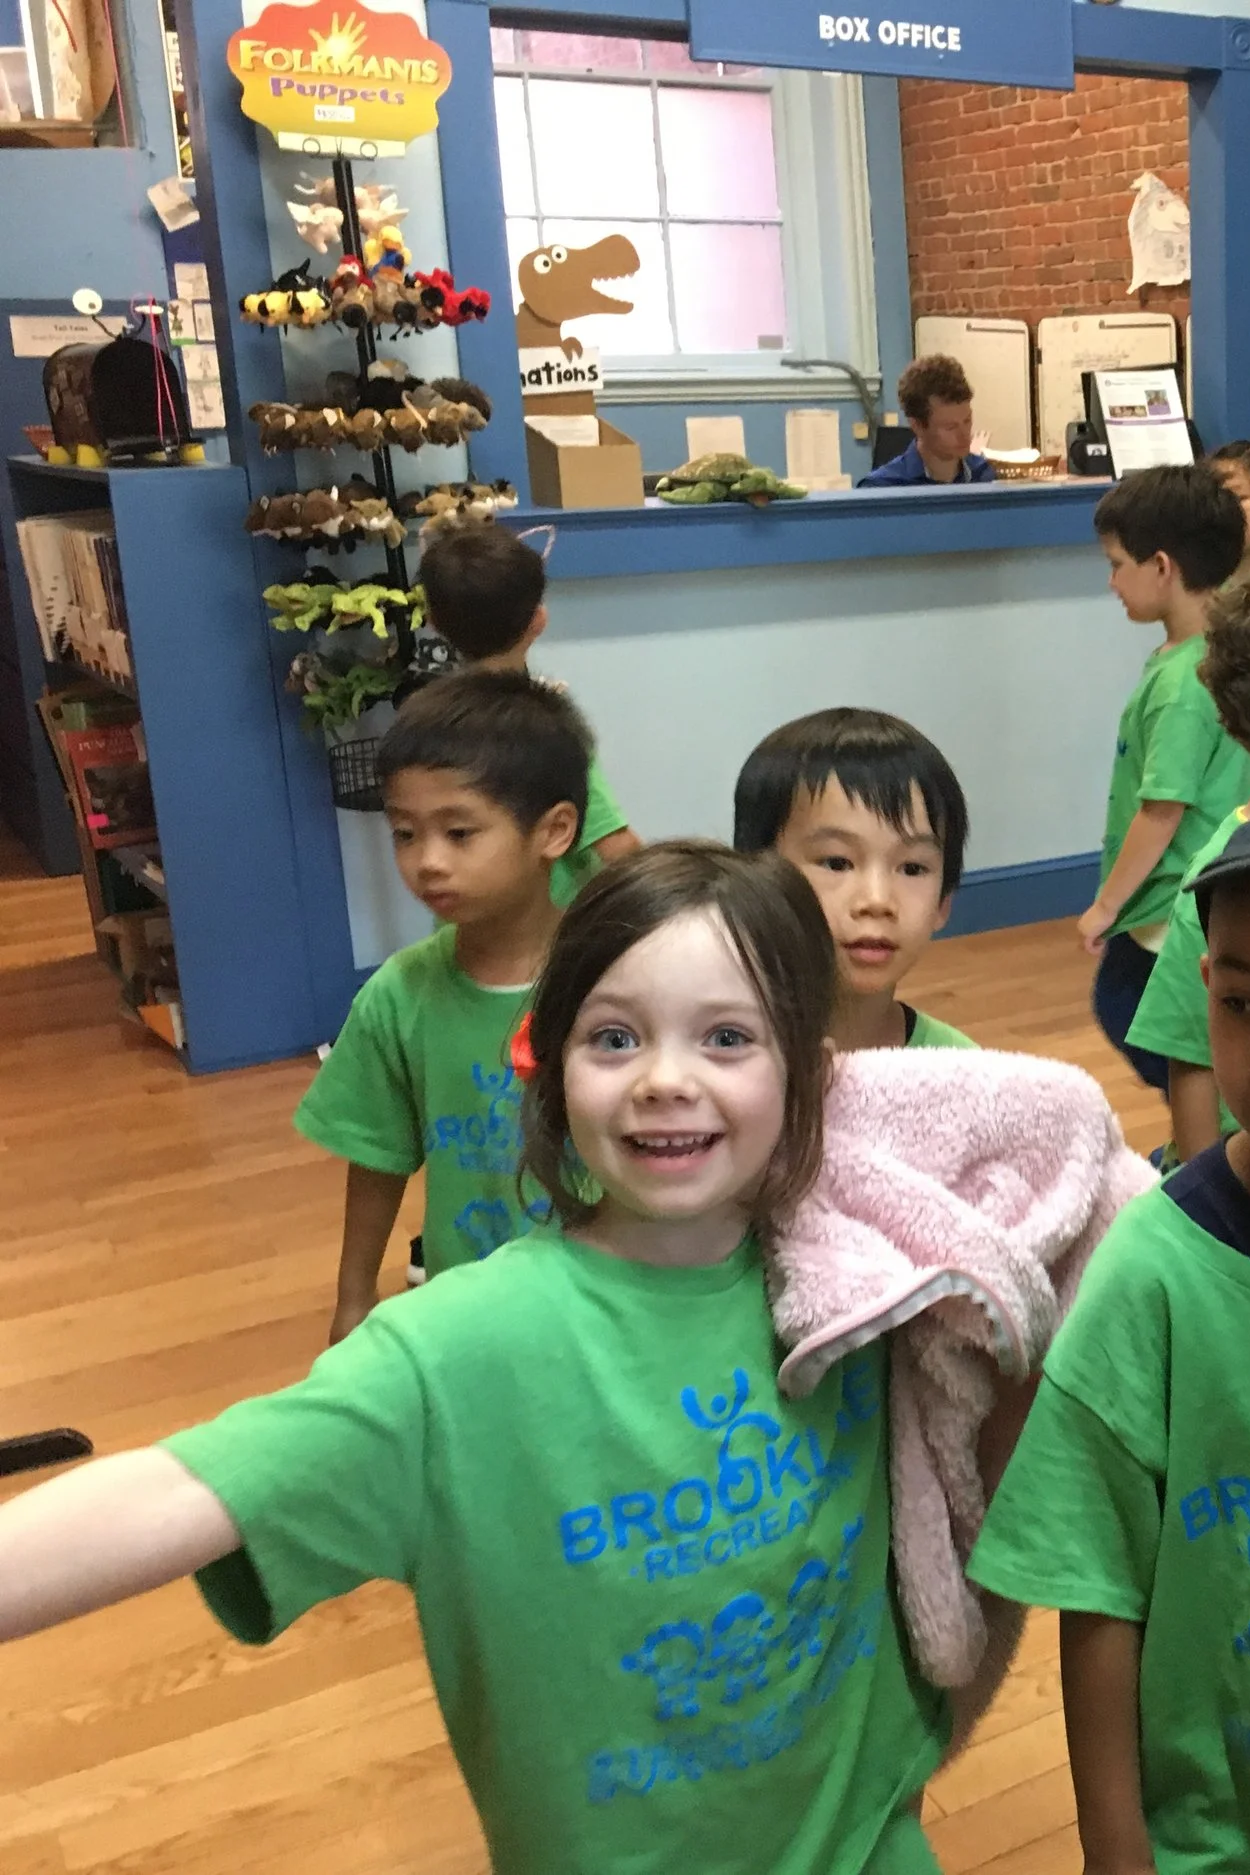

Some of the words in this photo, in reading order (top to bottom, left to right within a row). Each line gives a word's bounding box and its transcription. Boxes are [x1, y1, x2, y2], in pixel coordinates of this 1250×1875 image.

[818, 14, 871, 42] BOX
[878, 20, 961, 51] OFFICE
[239, 39, 440, 84] FOLKMANIS
[270, 77, 405, 105] Puppets
